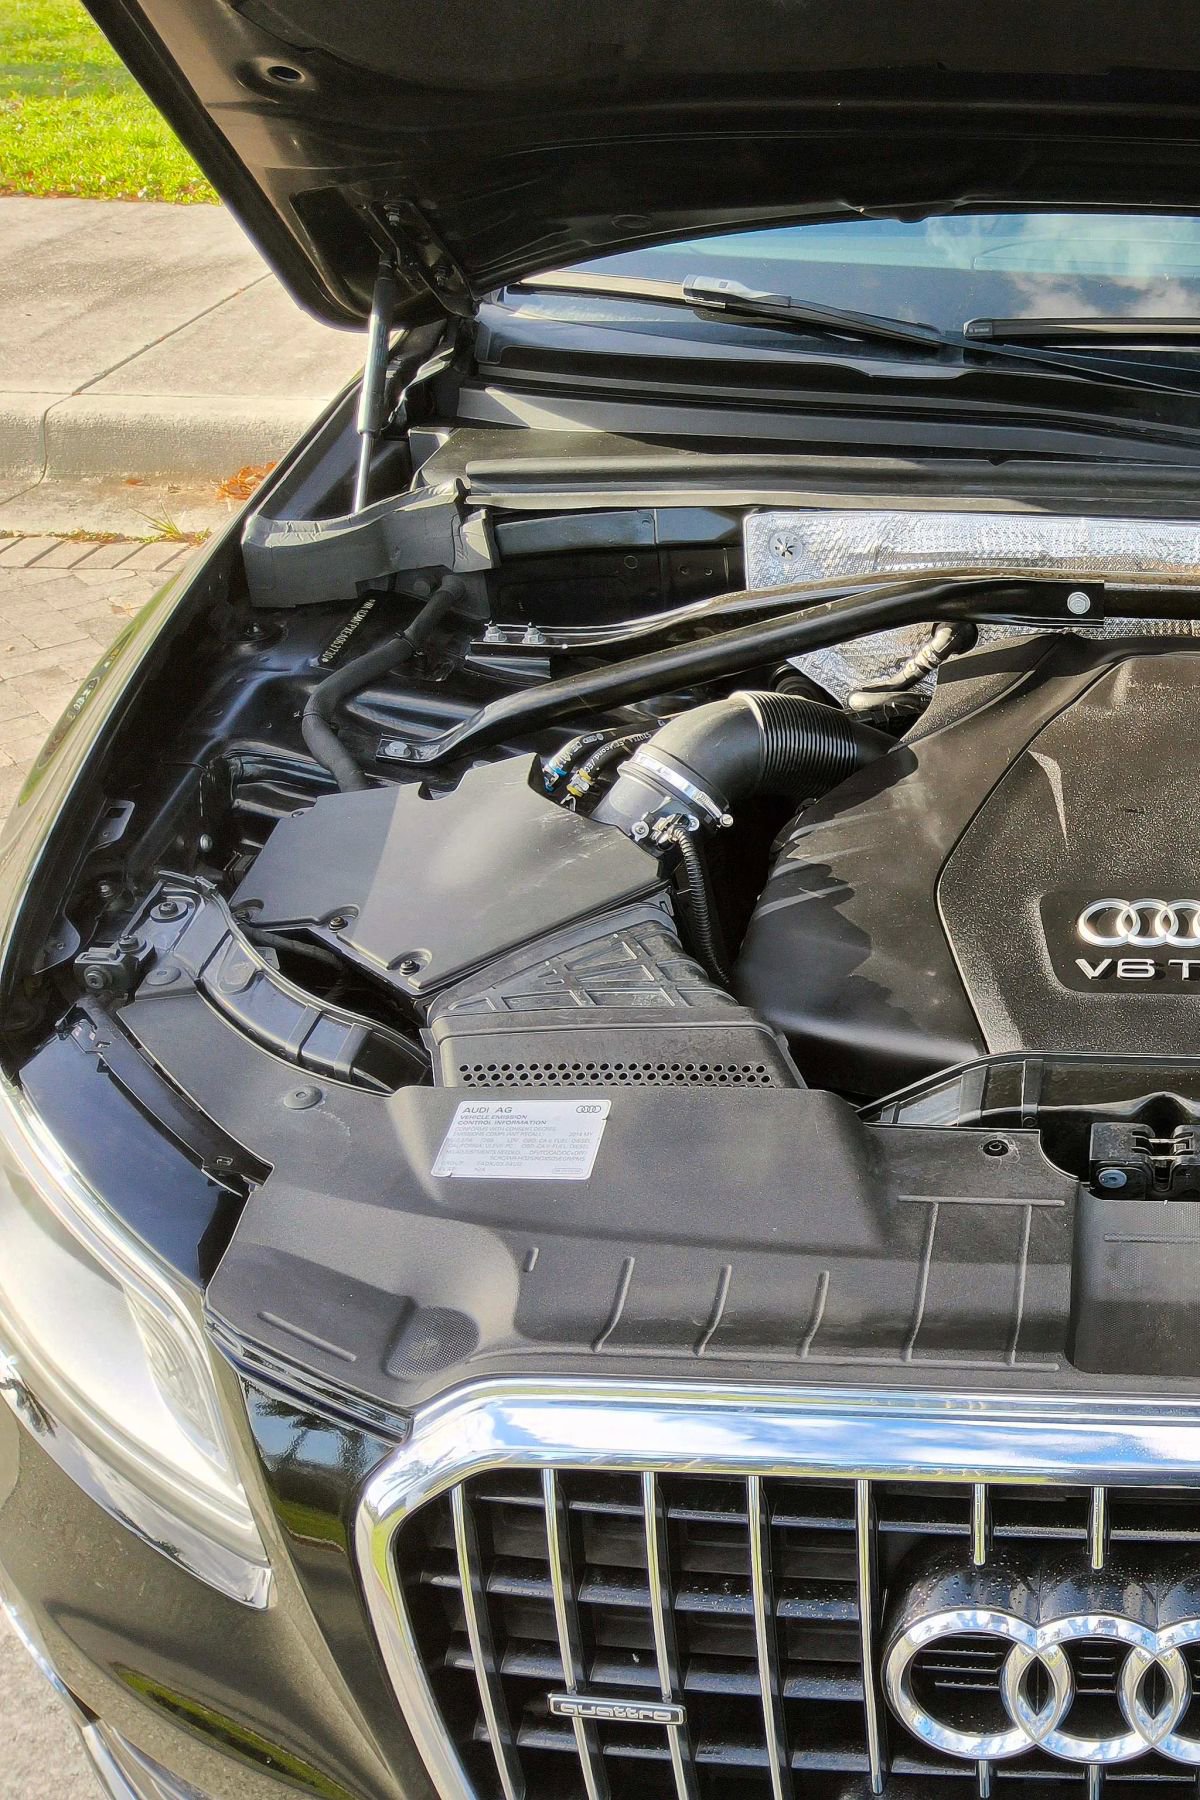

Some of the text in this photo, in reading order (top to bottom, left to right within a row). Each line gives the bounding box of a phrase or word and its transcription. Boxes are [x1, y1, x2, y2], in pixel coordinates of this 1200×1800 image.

[1075, 958, 1156, 980] V6
[462, 1106, 513, 1114] AUDI AG
[560, 1703, 672, 1721] quattro
